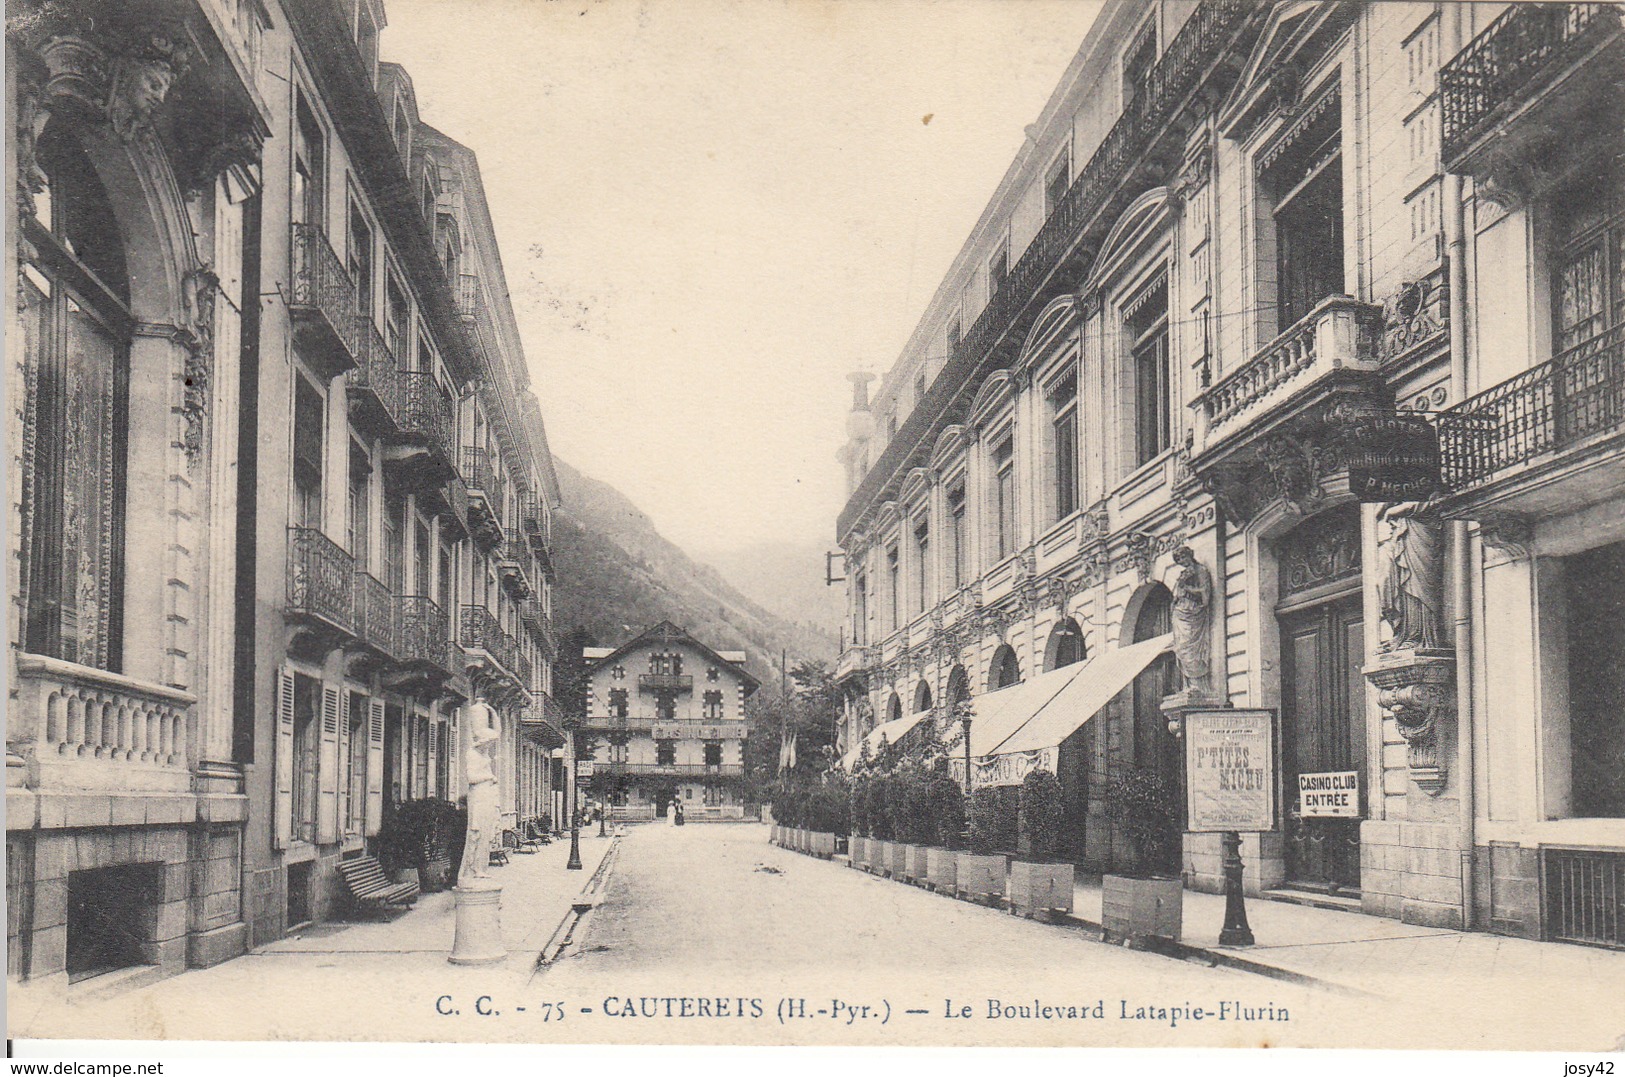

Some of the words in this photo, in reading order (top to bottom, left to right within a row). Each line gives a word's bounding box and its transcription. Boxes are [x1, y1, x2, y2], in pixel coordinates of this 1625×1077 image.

[1197, 746, 1250, 769] P'TITES
[1300, 776, 1331, 791] CASINO
[1332, 775, 1356, 789] CLUB
[1305, 790, 1349, 807] ENTRÉE
